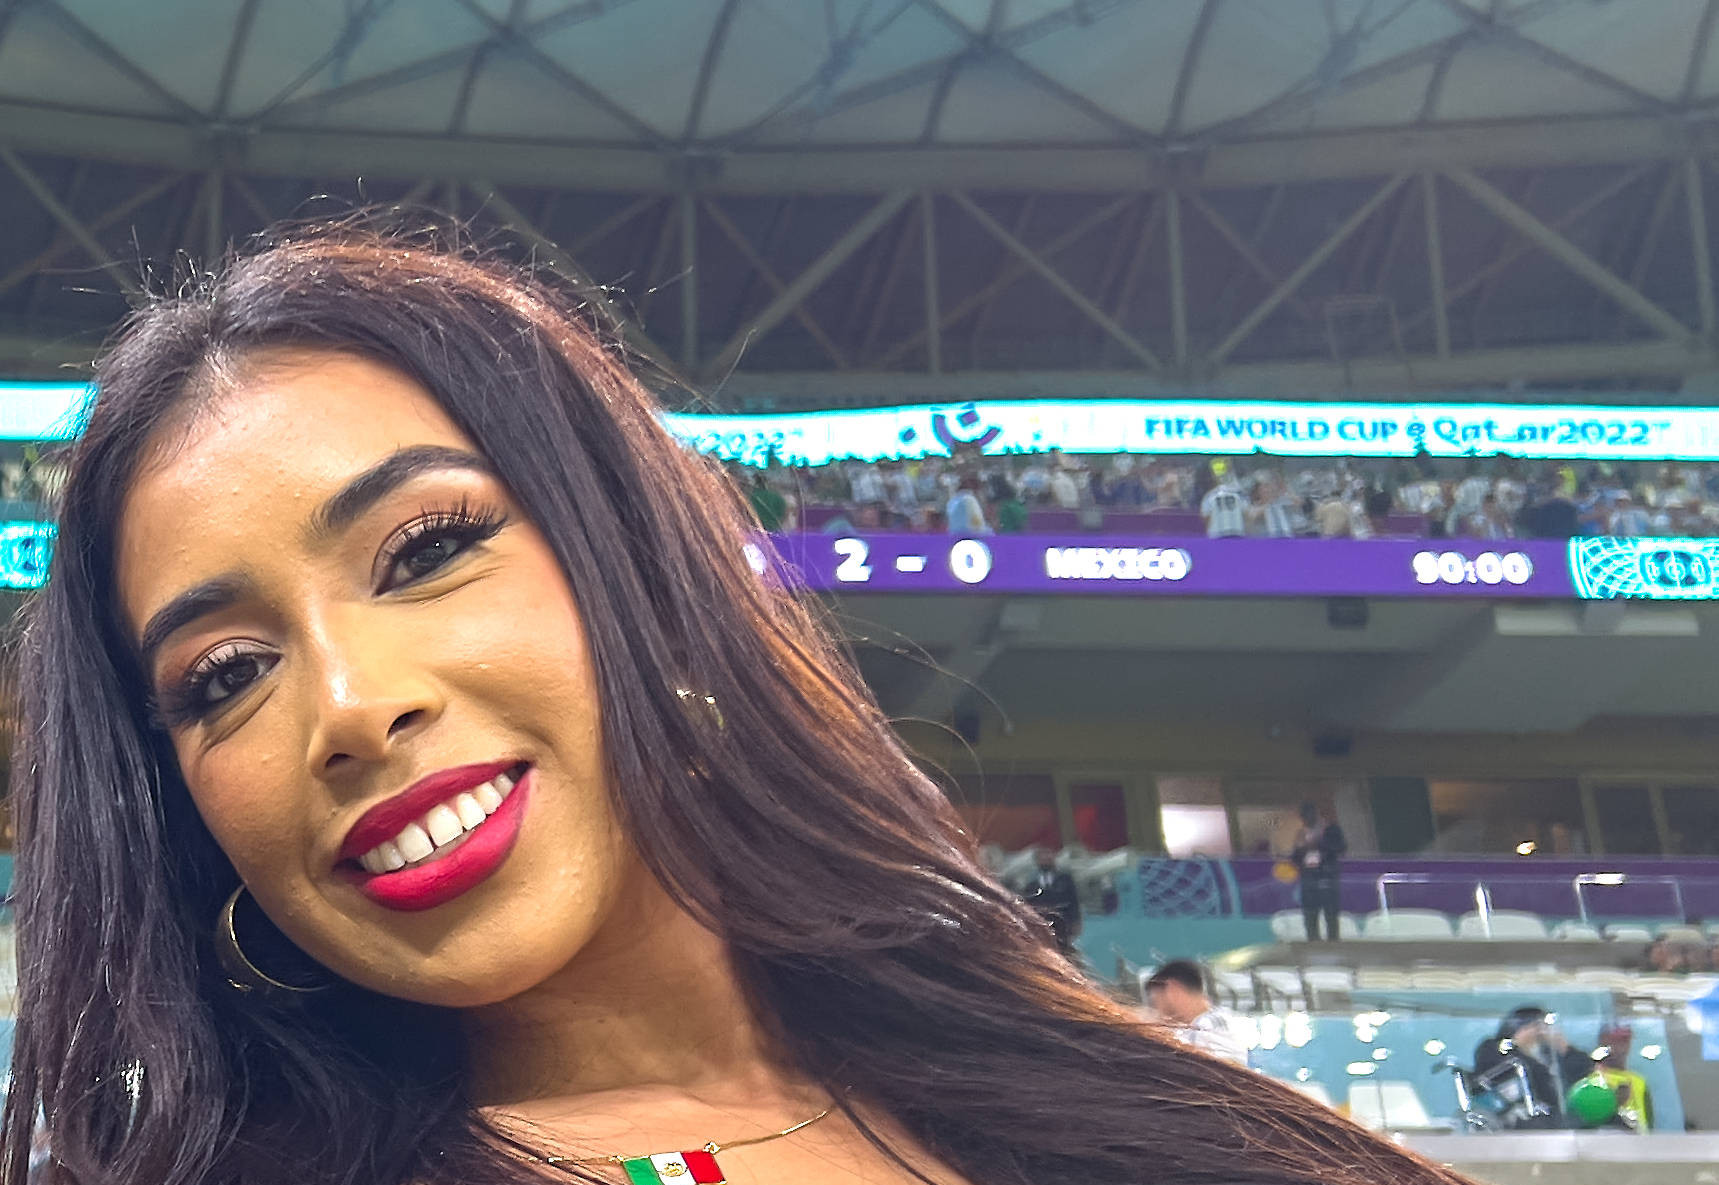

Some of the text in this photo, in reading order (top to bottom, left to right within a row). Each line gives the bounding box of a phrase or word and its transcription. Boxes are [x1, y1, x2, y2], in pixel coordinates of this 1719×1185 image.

[1144, 415, 1211, 438] FIFA
[1216, 416, 1330, 441] WORLD
[1336, 417, 1398, 442] CUP
[834, 538, 872, 582] 2
[949, 539, 991, 584] 0
[1045, 546, 1191, 581] MEXICO
[1412, 551, 1534, 585] 90:00
